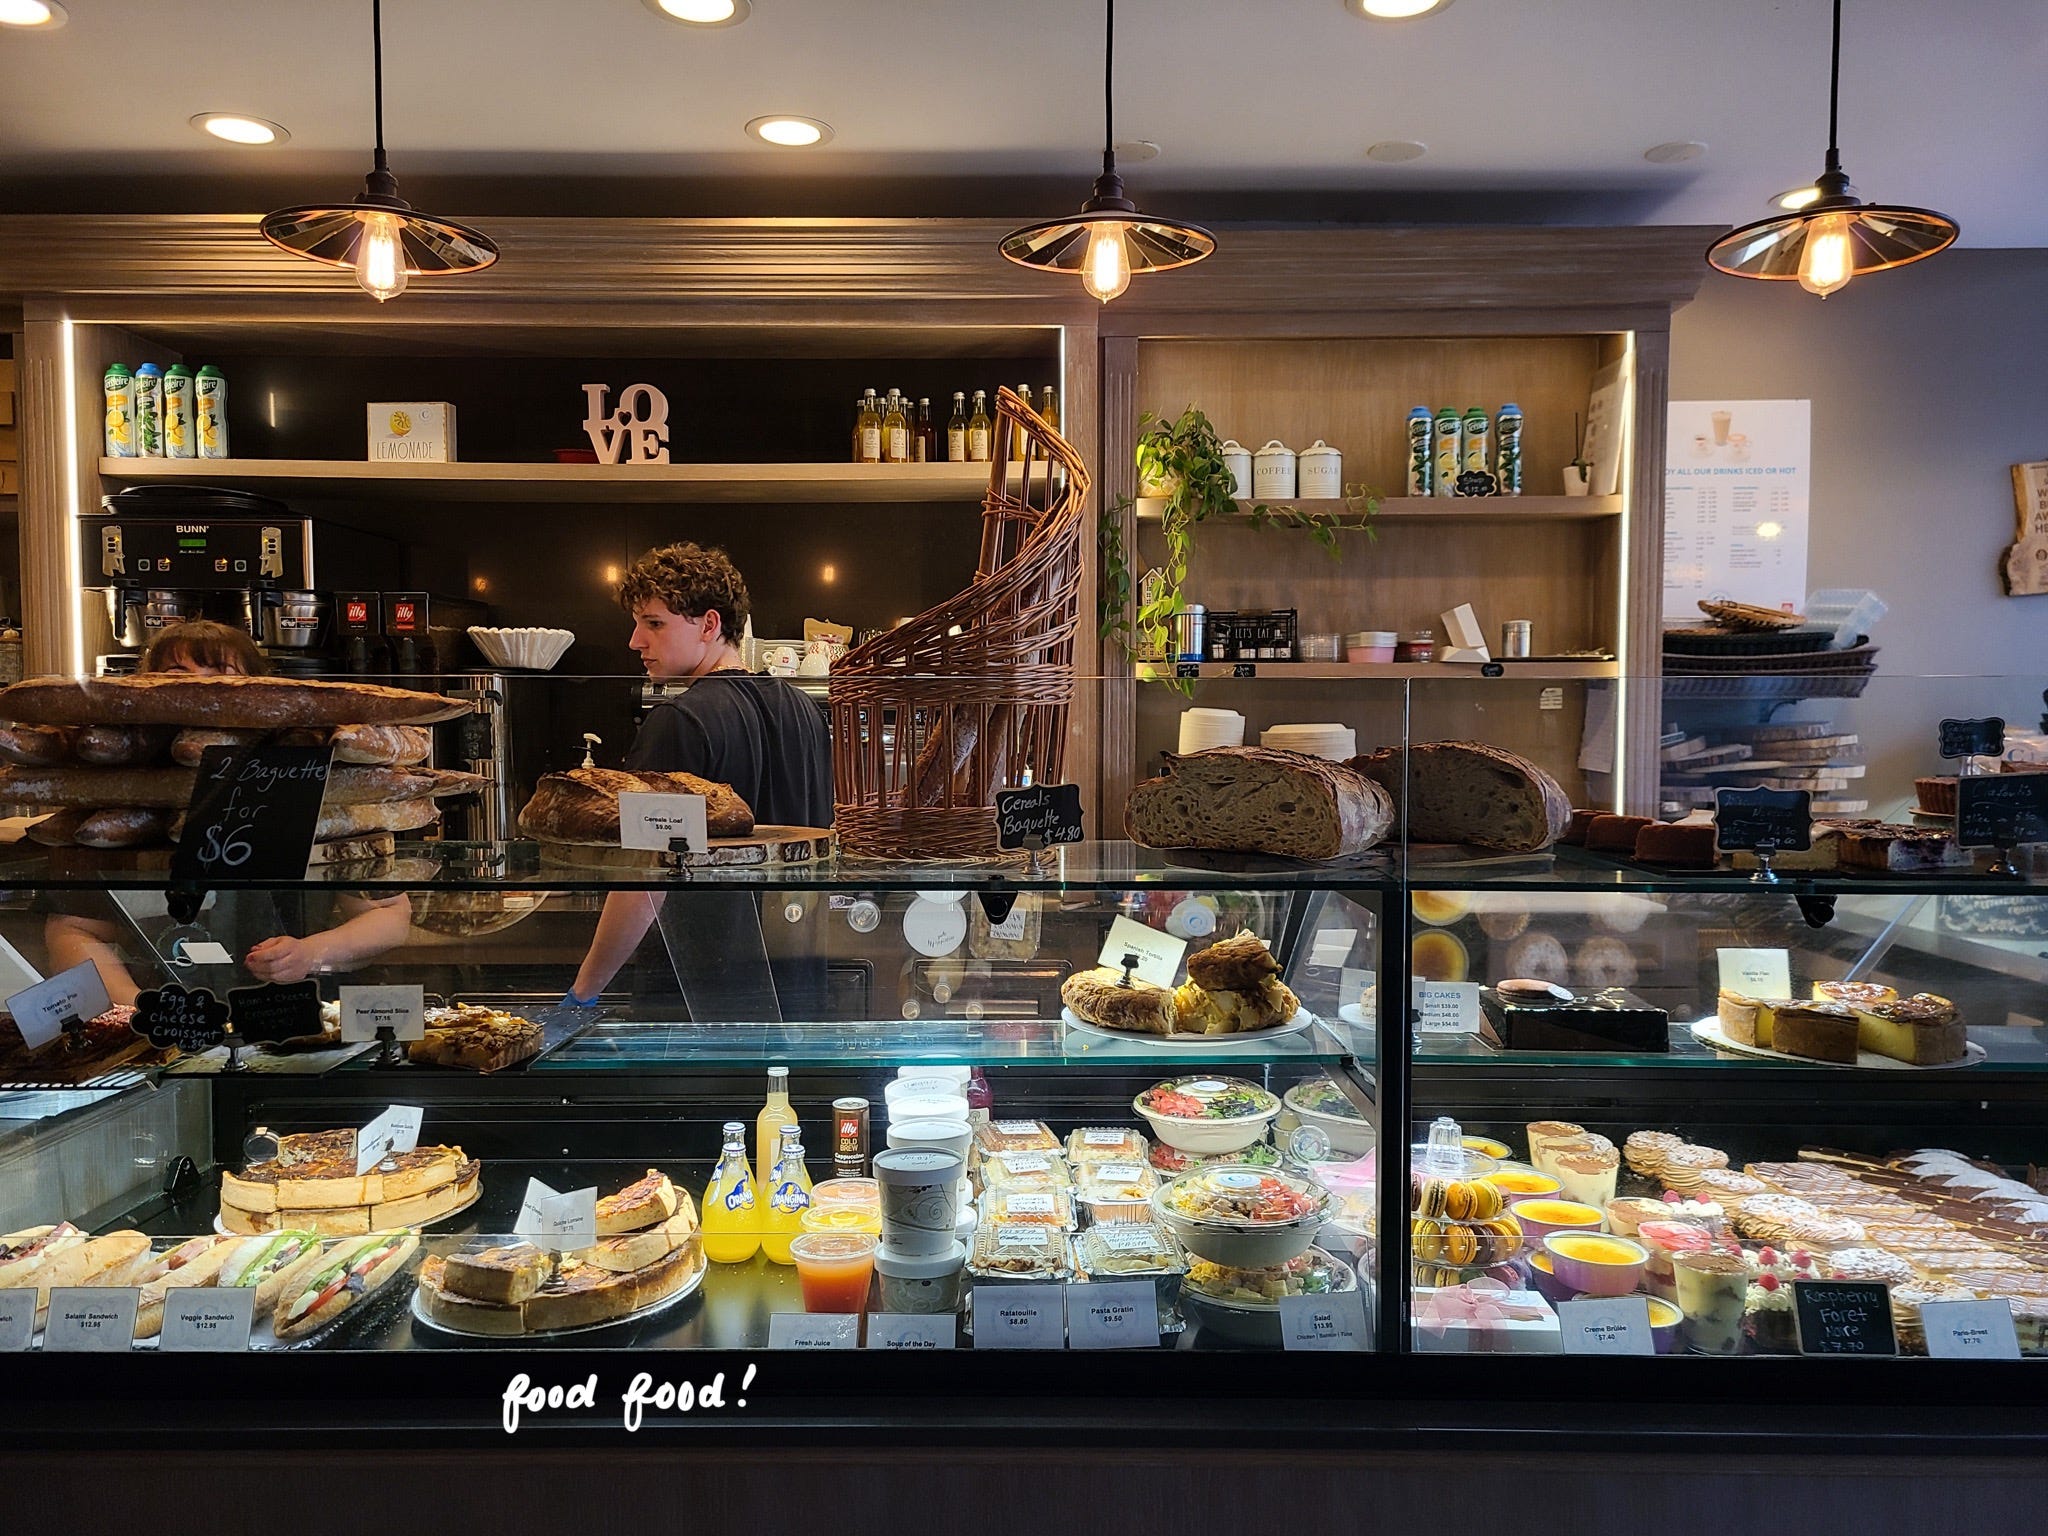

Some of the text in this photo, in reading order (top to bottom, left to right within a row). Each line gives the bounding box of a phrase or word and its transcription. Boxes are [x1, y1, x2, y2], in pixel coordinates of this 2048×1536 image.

[376, 441, 435, 460] LEMONADE
[1256, 466, 1292, 476] COFFEE
[1307, 466, 1339, 476] SUGAR
[1677, 468, 1692, 476] ALL
[1694, 467, 1712, 476] OUR
[1714, 467, 1743, 475] DRINKS
[1745, 467, 1764, 475] ICED
[1765, 466, 1777, 475] OR
[1779, 466, 1797, 475] HOT
[176, 525, 205, 533] BUNN
[349, 605, 366, 620] illy
[397, 606, 414, 621] illy
[1235, 627, 1270, 639] LET'S EAT
[210, 756, 232, 780] 2
[222, 786, 269, 822] for
[196, 823, 255, 873] $6
[1123, 941, 1145, 954] Spanish
[1418, 991, 1461, 999] BIG CAKES
[43, 998, 67, 1013] Tomato
[160, 992, 188, 1014] Egg
[1425, 1020, 1441, 1028] Large
[842, 1122, 857, 1136] illy
[834, 1152, 865, 1161] Cappuccino
[771, 1192, 810, 1207] ORANGINA
[1804, 1288, 1879, 1308] Raspberry
[1000, 1309, 1037, 1317] Ratatouille
[1112, 1306, 1134, 1314] Gratin
[180, 1314, 202, 1322] Veggie
[1103, 1315, 1123, 1323] $9.50
[1314, 1314, 1331, 1322] Salad
[886, 1340, 903, 1349] Soup
[923, 1341, 937, 1349] Day
